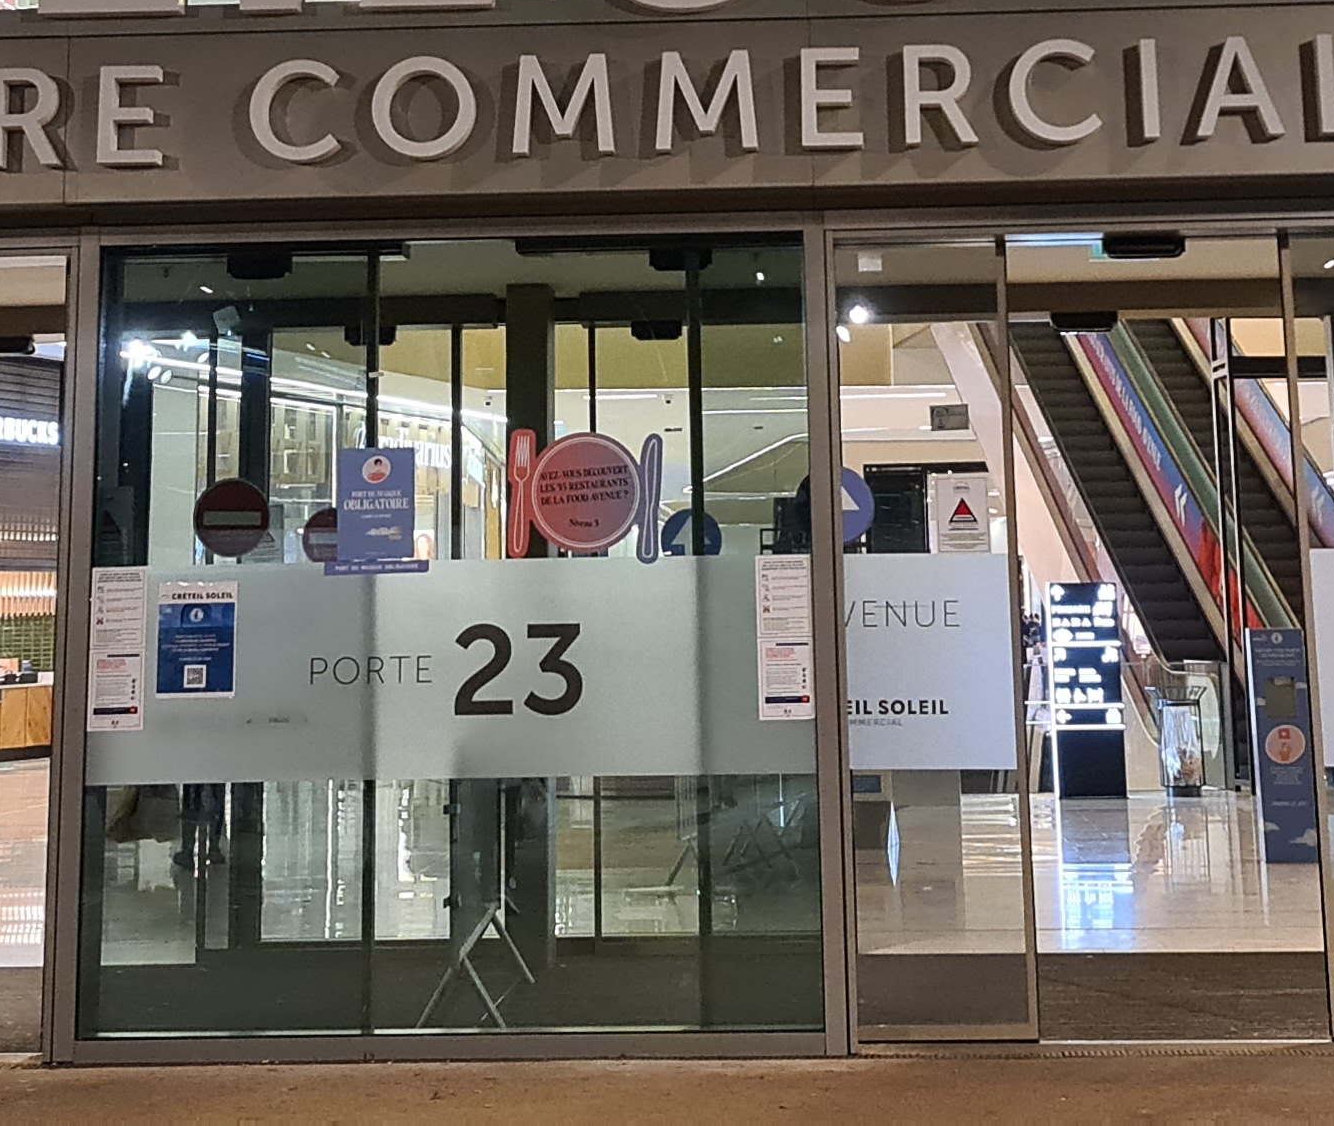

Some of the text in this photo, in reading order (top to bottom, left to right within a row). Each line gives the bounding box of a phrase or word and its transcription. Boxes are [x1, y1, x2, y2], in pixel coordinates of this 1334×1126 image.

[568, 478, 629, 491] RESTAURANTS
[566, 493, 589, 504] FOOD
[590, 491, 622, 502] AVENUE
[343, 498, 409, 511] OBLIGATOIRE
[171, 591, 233, 600] CRÉTEIL SOLEIL
[310, 623, 584, 716] PORTE 23
[878, 699, 949, 716] SOLEIL
